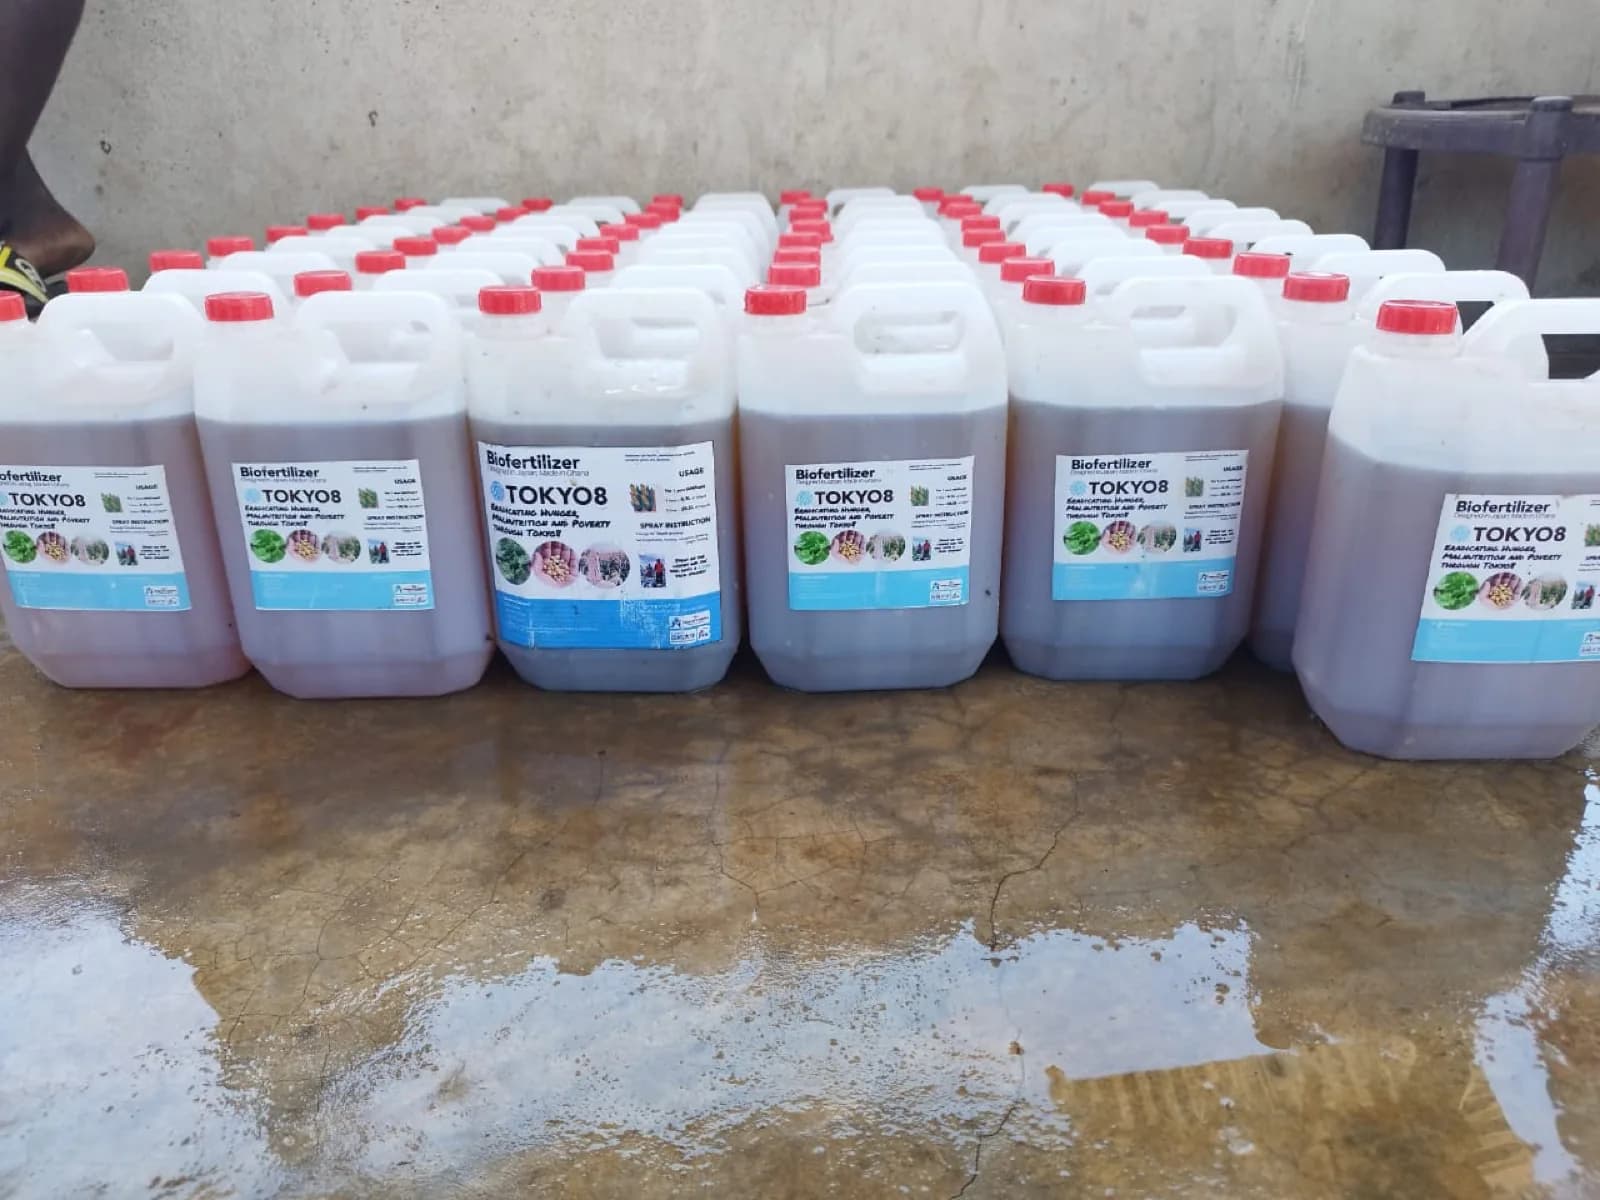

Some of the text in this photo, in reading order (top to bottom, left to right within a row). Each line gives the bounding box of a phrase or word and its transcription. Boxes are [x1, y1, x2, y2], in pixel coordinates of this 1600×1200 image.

[486, 450, 581, 470] Biofertilizer
[1071, 458, 1152, 470] Biofertilizer
[240, 466, 320, 477] Biofertilizer
[796, 468, 876, 480] Biofertilizer
[1088, 480, 1169, 495] TOKYO8
[8, 492, 86, 507] TOKYO8
[262, 489, 341, 503] TOKYO8
[505, 485, 608, 505] TOKYO8
[814, 489, 894, 504] TOKYO8
[1455, 499, 1551, 513] Biofertilizer
[572, 519, 611, 528] POVERTY
[639, 516, 711, 529] SPRAY INSTRUCTION
[1473, 526, 1566, 542] TOKYO8
